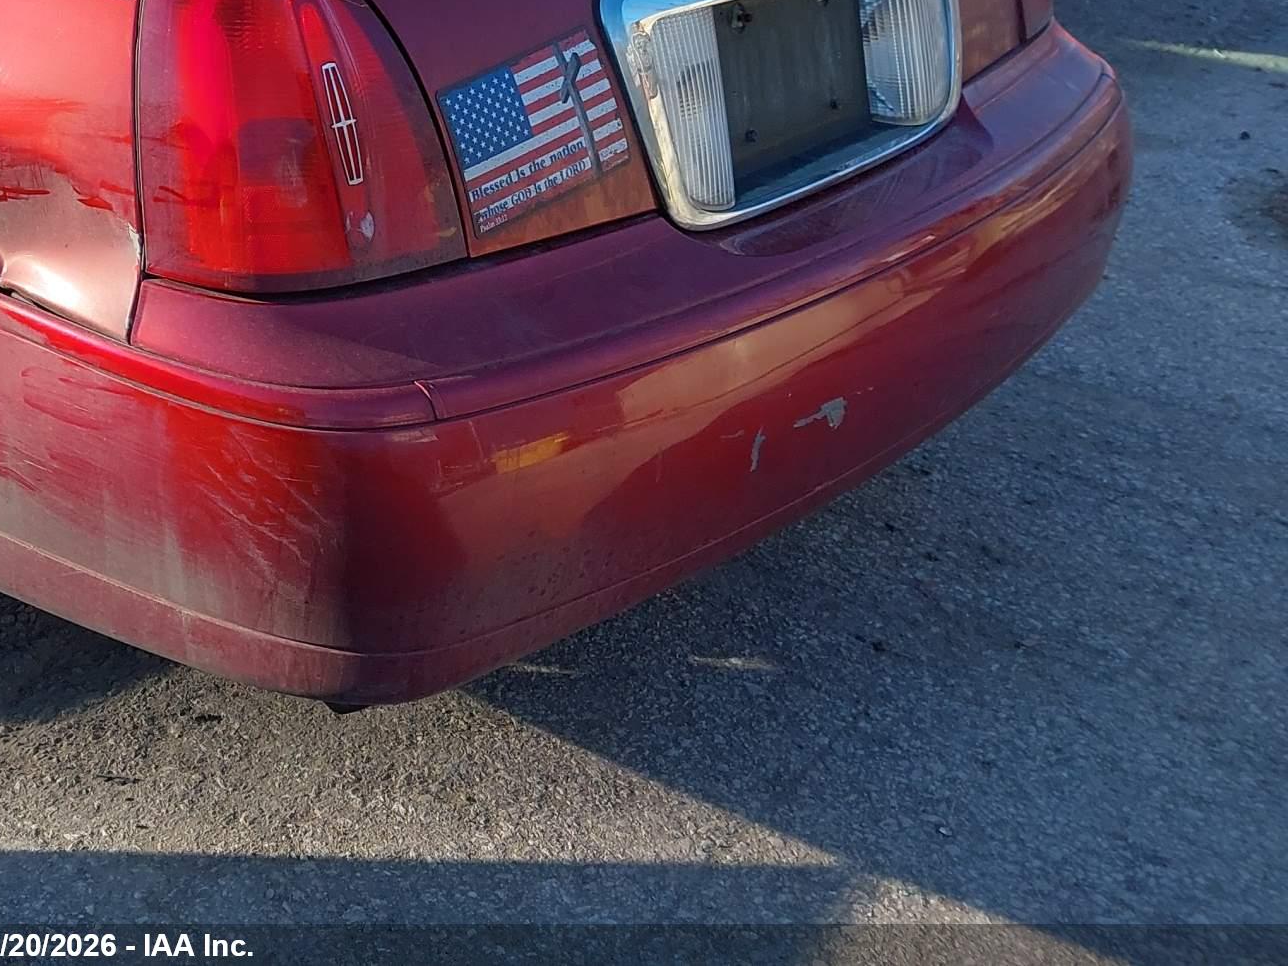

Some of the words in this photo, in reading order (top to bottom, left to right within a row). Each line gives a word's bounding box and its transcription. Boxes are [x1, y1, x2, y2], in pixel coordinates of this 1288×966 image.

[471, 174, 513, 200] Blessed
[528, 157, 546, 173] the
[549, 140, 584, 162] nation
[544, 175, 559, 189] the
[560, 161, 586, 182] LORD
